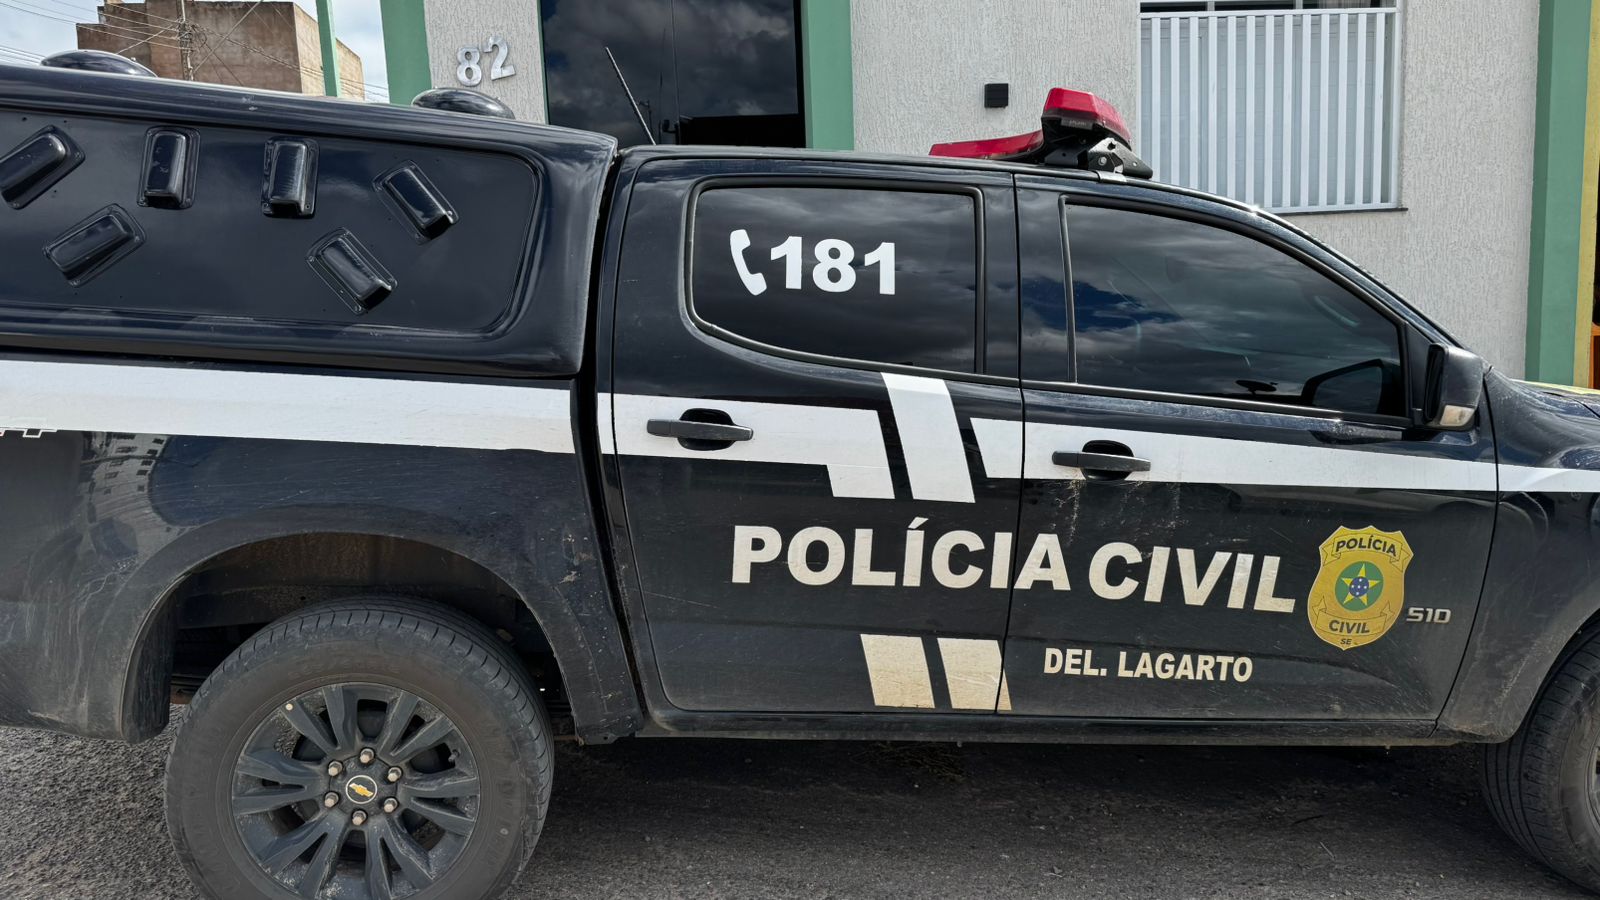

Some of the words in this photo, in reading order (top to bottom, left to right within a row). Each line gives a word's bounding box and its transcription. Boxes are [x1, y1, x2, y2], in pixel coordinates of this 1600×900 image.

[457, 36, 516, 87] 82
[770, 235, 896, 296] 181
[1335, 535, 1397, 557] POLÍCIA
[731, 516, 1071, 592] POLÍCIA
[1088, 541, 1296, 614] CIVIL
[1328, 619, 1370, 634] CIVIL
[1406, 606, 1452, 624] S10
[1340, 638, 1353, 646] SE
[1043, 647, 1108, 678] DEL.
[1117, 650, 1253, 683] LAGARTO
